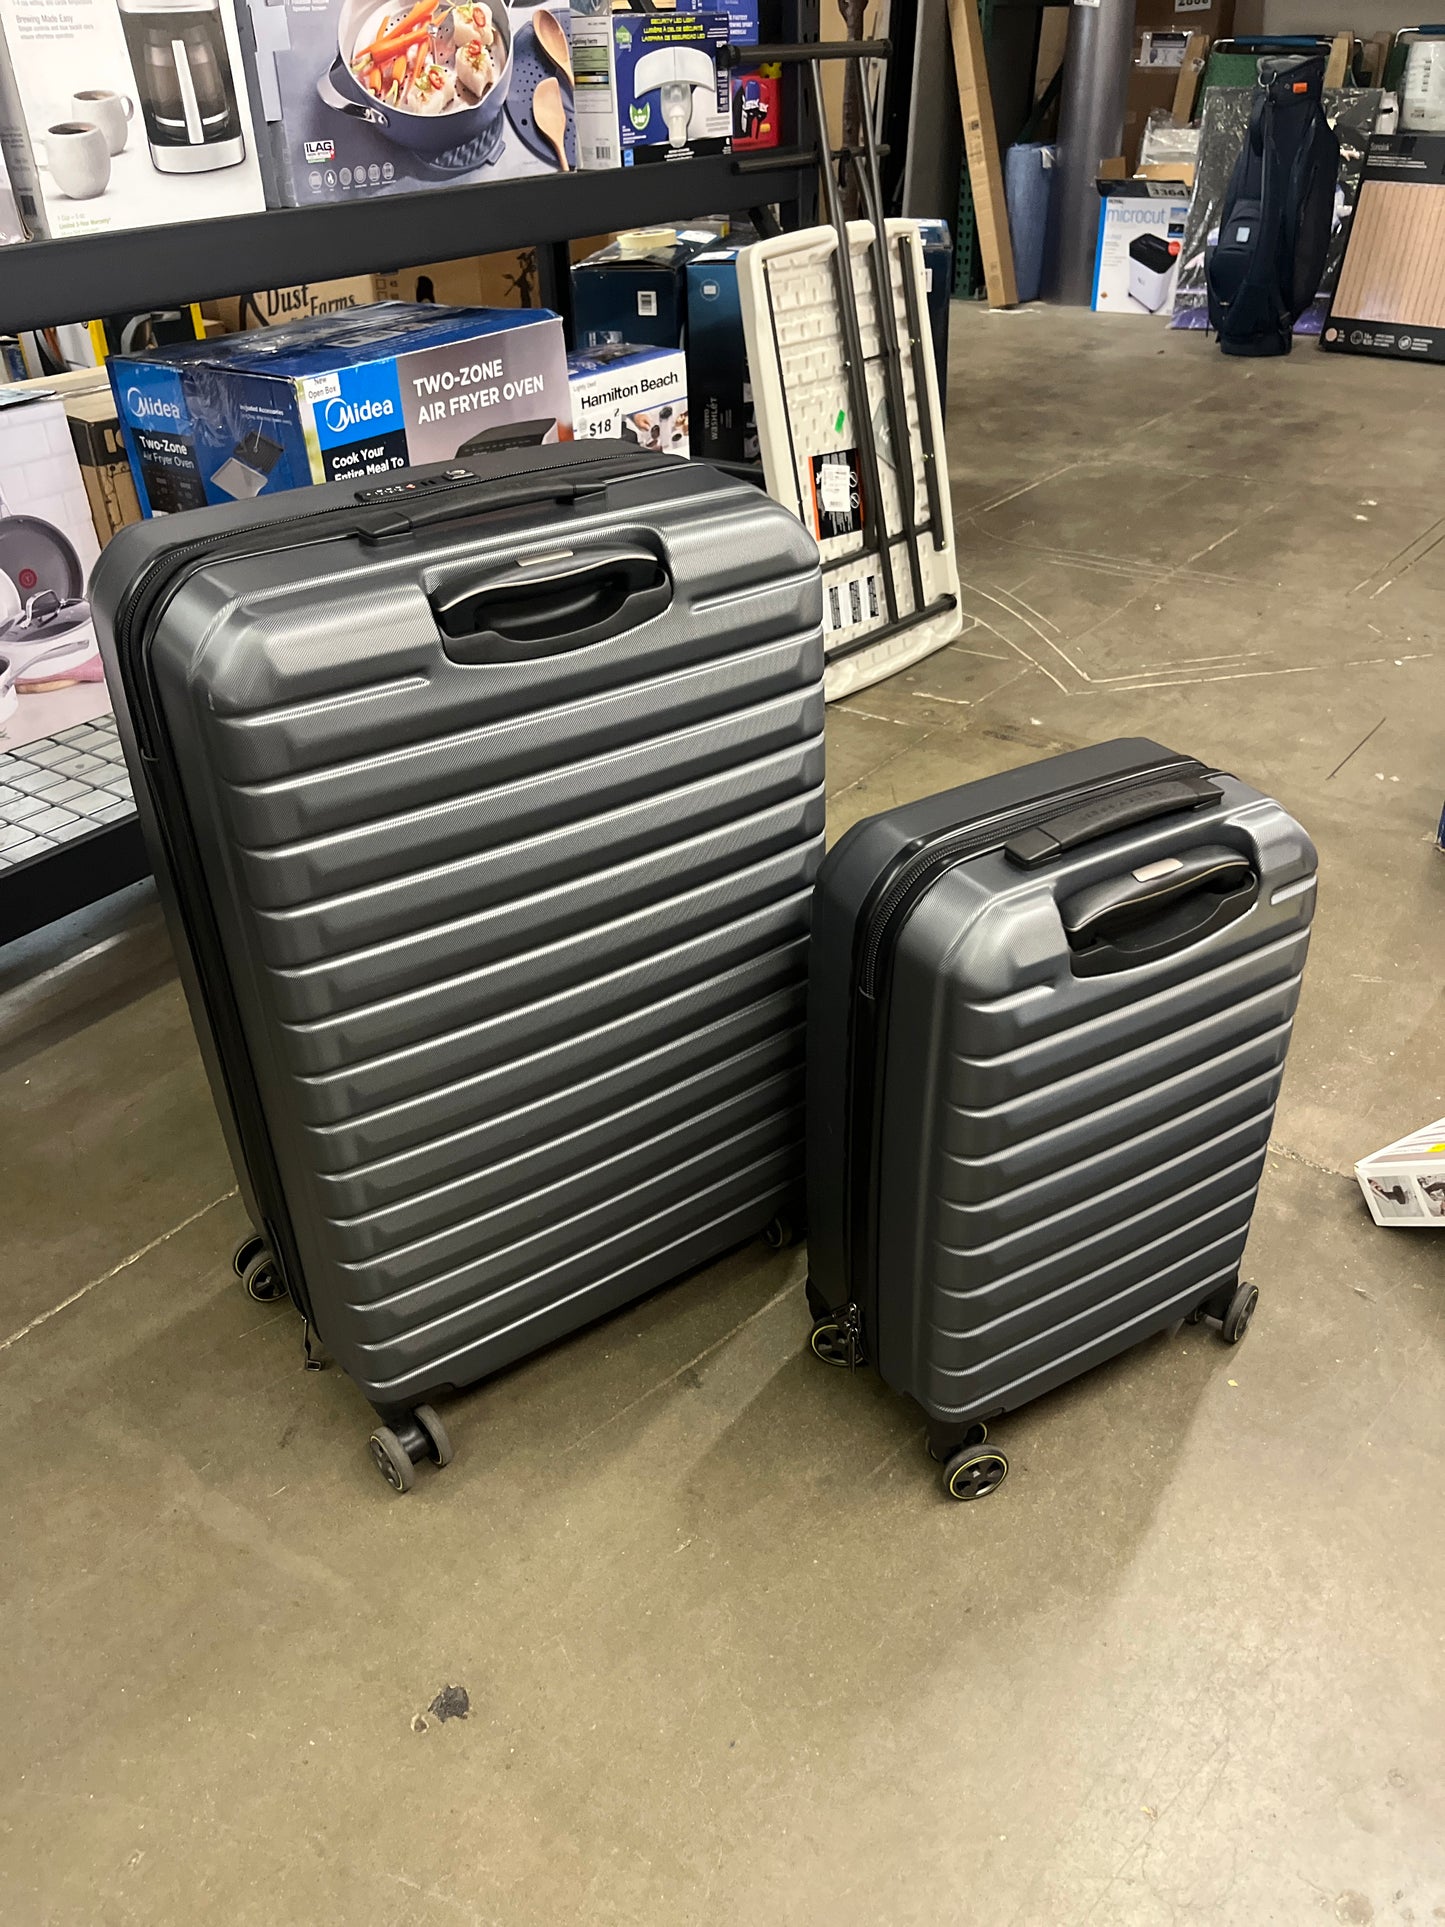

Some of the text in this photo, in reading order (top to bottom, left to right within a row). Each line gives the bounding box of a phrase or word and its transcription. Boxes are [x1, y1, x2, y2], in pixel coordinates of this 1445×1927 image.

[16, 14, 73, 24] Brewing Made Easy
[305, 142, 332, 152] ILAG
[1107, 208, 1166, 224] microcut
[267, 285, 309, 316] Dust
[310, 294, 356, 316] Farms
[314, 378, 326, 386] New
[413, 359, 504, 397] TWO-ZONE
[308, 385, 337, 400] Open Box
[418, 374, 544, 424] AIR FRYER OVEN
[581, 372, 679, 410] Hamilton Beach
[127, 387, 180, 419] Midea
[325, 397, 394, 432] Midea
[590, 418, 612, 437] $18
[139, 436, 188, 456] Two-Zone
[153, 452, 173, 466] Fryer
[174, 456, 194, 469] Oven
[332, 446, 384, 469] Cook Your
[334, 456, 404, 482] Entire Meal To
